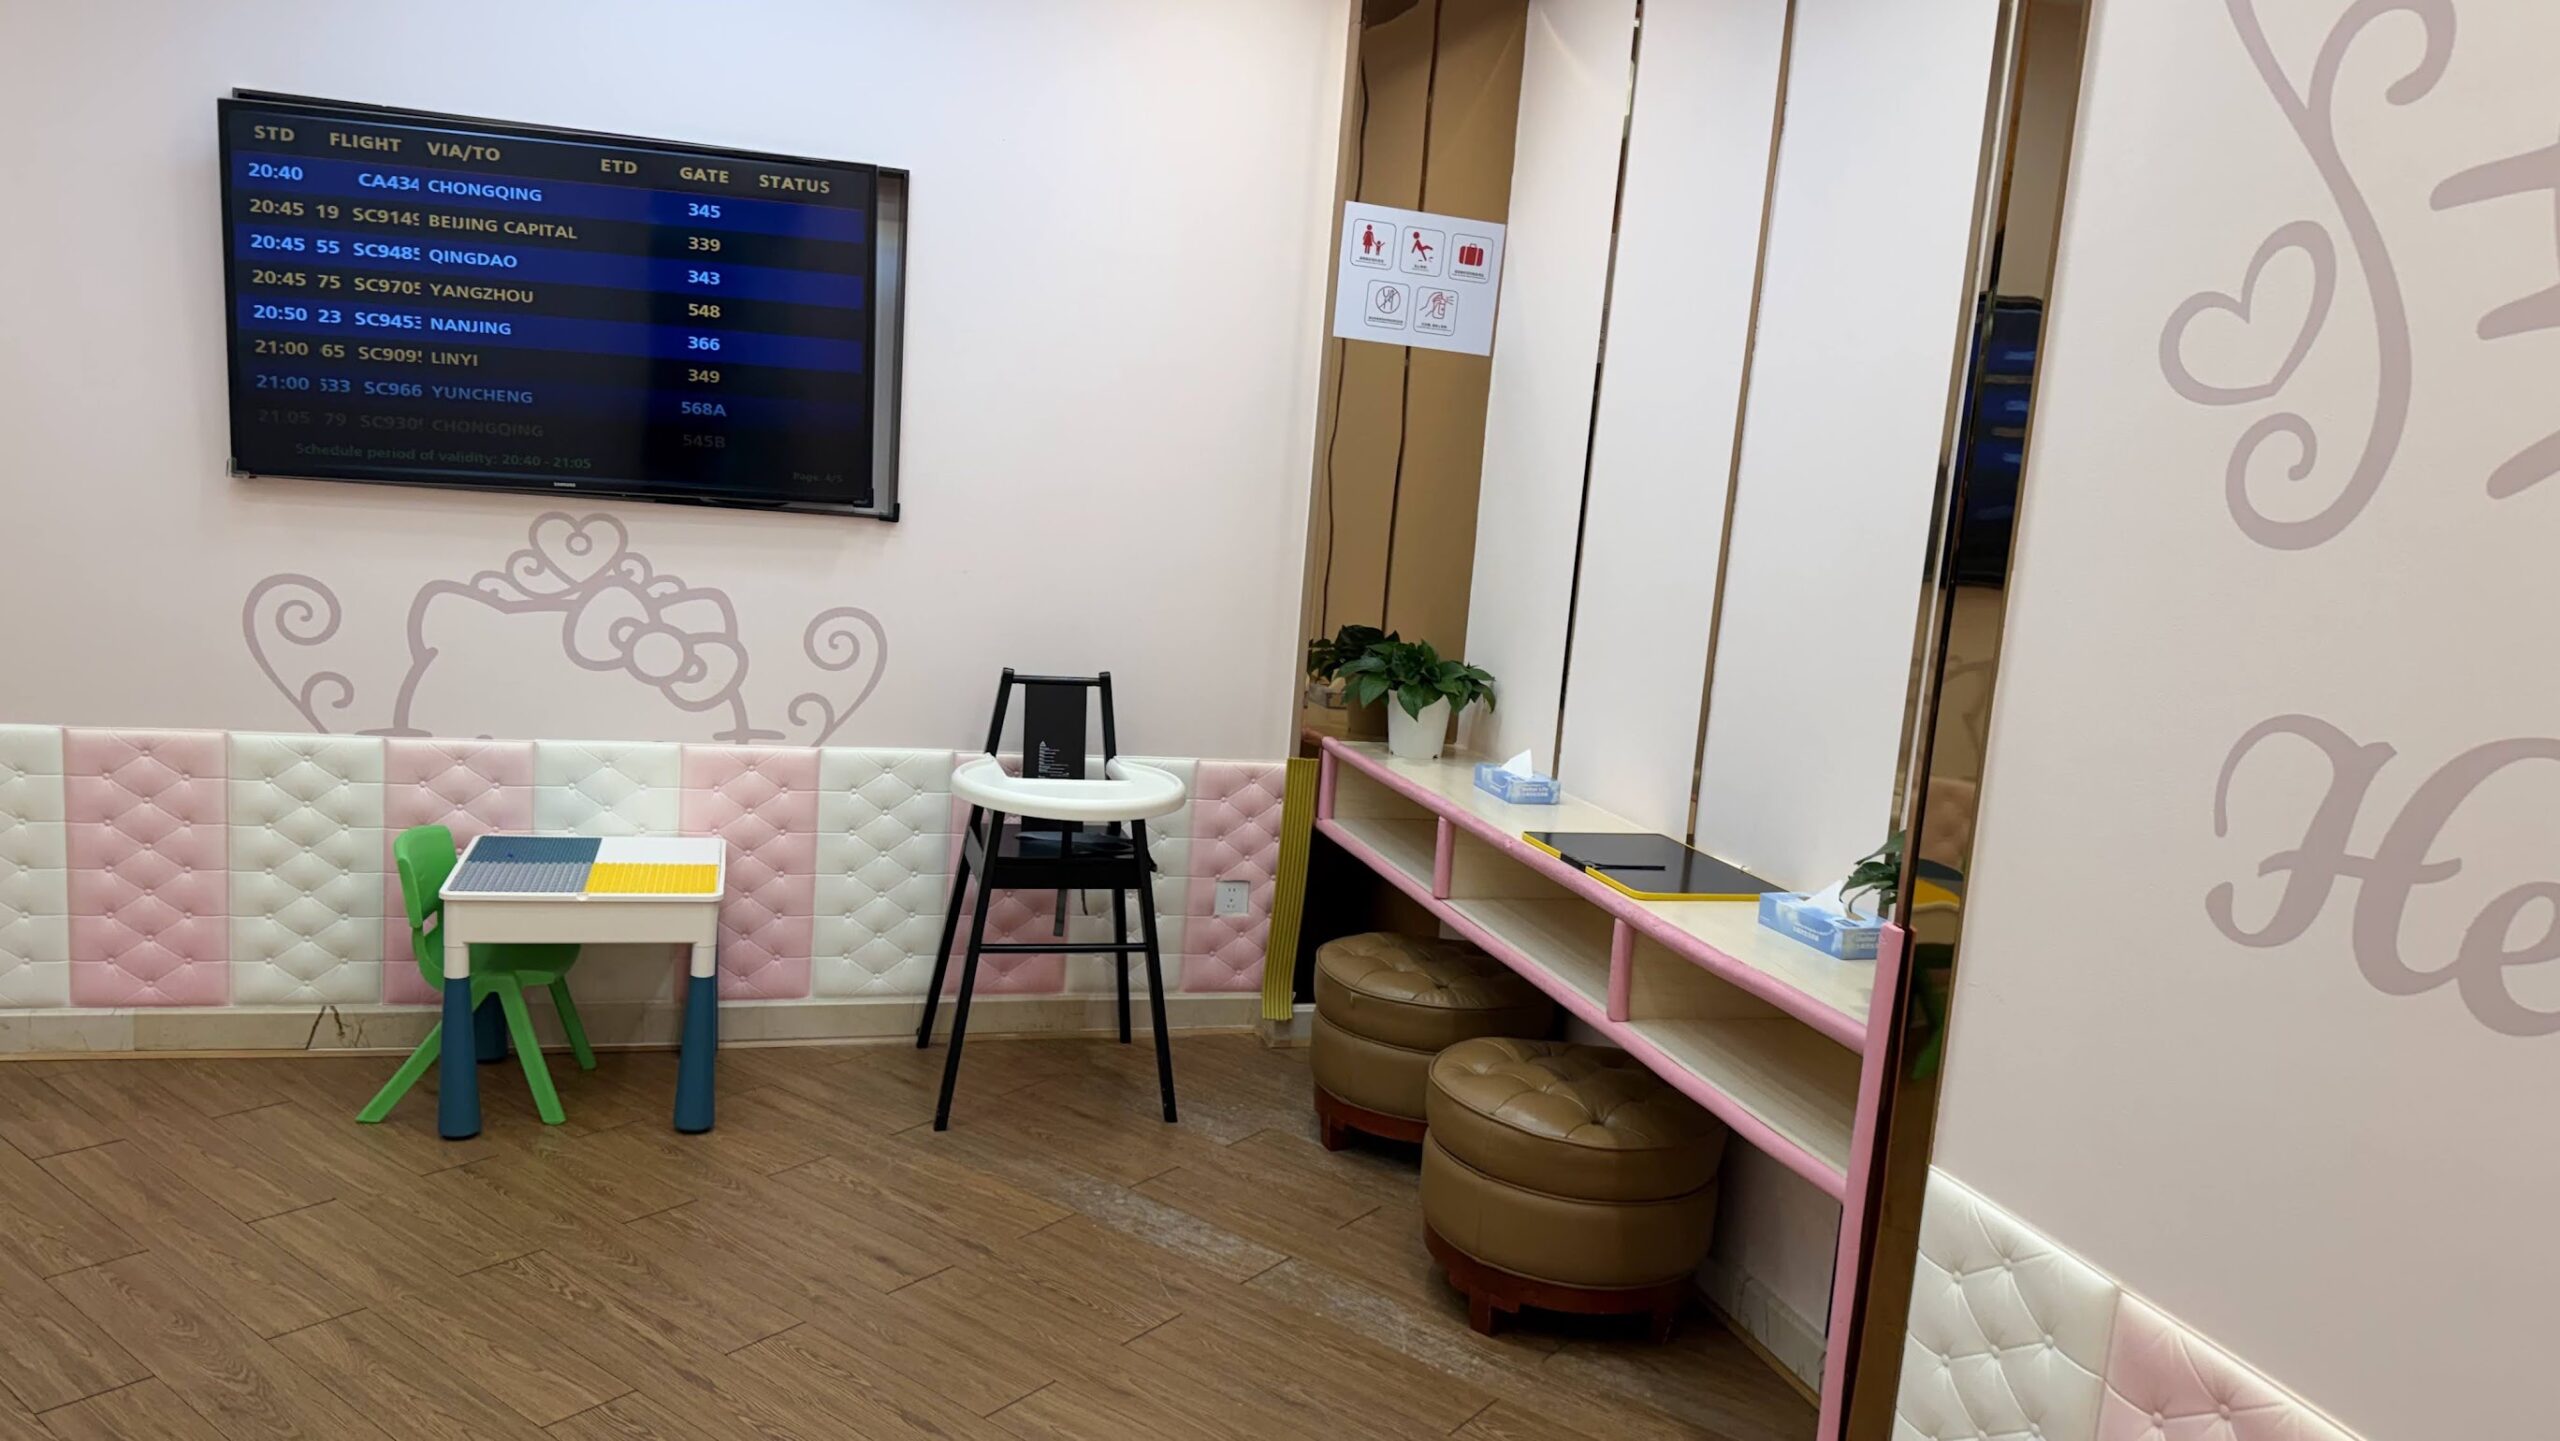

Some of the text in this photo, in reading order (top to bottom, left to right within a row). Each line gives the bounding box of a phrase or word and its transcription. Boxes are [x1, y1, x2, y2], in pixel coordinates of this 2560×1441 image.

[254, 125, 830, 193] STD FLIGHT VIA/TO ETD GATE STATUS
[248, 162, 304, 180] 20:40
[427, 179, 542, 202] CHONGQING
[688, 203, 720, 218] 345
[249, 198, 304, 216] 20:45
[316, 205, 338, 218] 19
[429, 214, 498, 232] BEIJING
[503, 221, 578, 240] CAPITAL
[688, 237, 720, 252] 339
[250, 233, 305, 252] 20:45
[316, 239, 340, 254] 55
[429, 249, 518, 268] QINGDAO
[688, 270, 720, 285] 343
[252, 269, 306, 286] 20:45
[317, 275, 340, 288] 75
[430, 283, 534, 303] YANGZHOU
[688, 304, 720, 318] 548
[253, 305, 308, 321] 20:50
[318, 310, 342, 324] 23
[430, 318, 512, 335] NANJING
[688, 336, 720, 350] 366
[255, 340, 308, 356] 21:00
[431, 352, 478, 366] LINYI
[688, 369, 720, 382] 349
[256, 375, 309, 391] 21:00
[364, 381, 422, 397] SC966
[431, 386, 532, 404] YUNCHENG
[681, 401, 726, 417] 568A
[432, 419, 544, 438] CHONGQING
[296, 443, 362, 456] Schedule
[368, 447, 415, 460] period
[420, 450, 434, 460] of
[439, 451, 496, 466] validity:
[502, 454, 541, 466] 20:40
